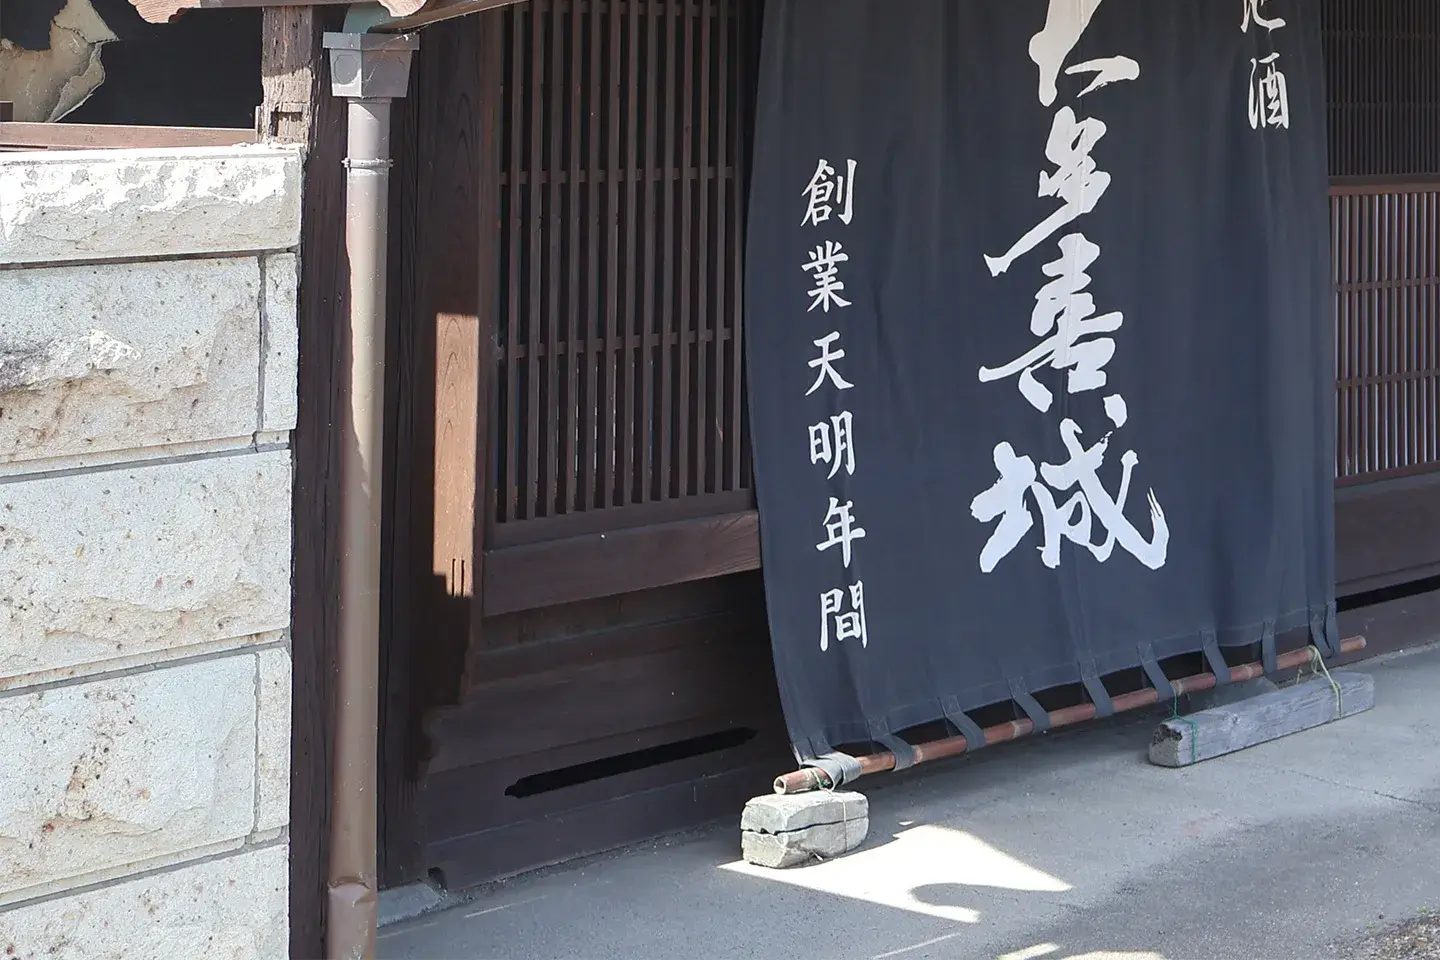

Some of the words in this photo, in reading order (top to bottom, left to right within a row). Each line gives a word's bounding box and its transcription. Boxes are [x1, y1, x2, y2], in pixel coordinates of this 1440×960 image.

[800, 158, 868, 652] 創業天明年間
